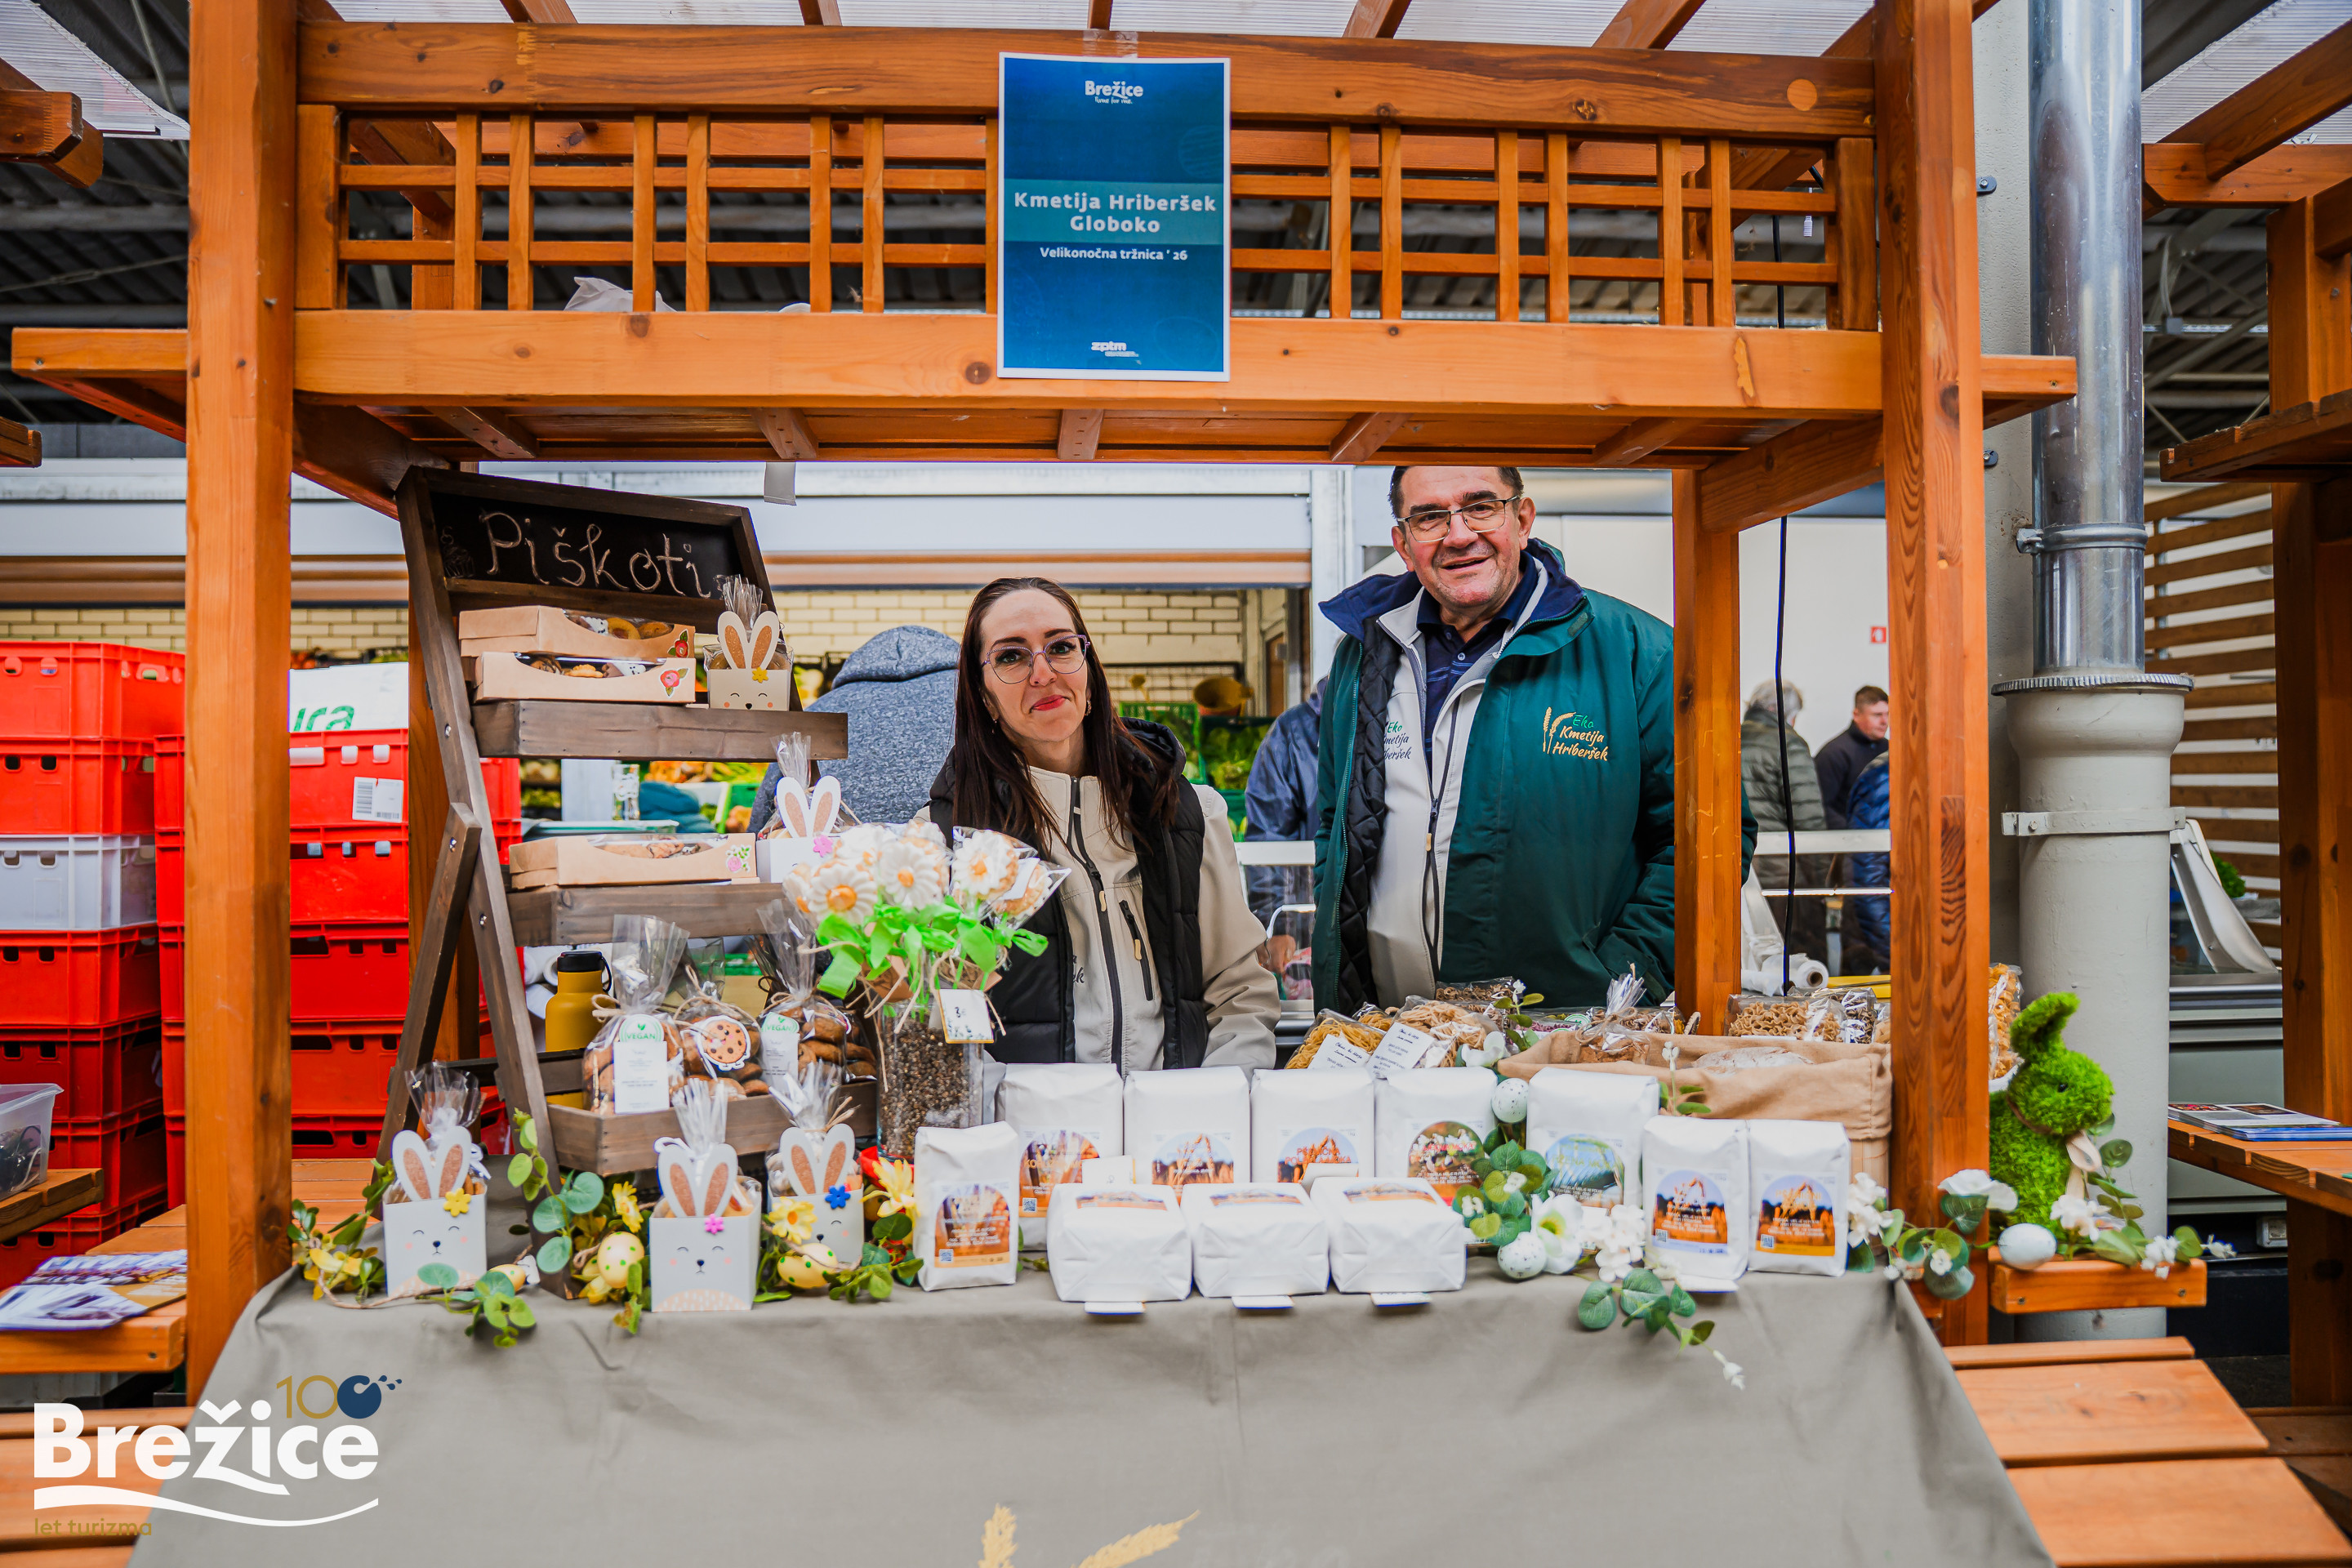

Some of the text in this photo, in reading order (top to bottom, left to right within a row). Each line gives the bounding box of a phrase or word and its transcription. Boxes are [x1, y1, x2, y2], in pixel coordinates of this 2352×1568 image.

[1085, 80, 1143, 99] Brežice
[1013, 192, 1216, 213] Kmetija Hriberšek
[1070, 216, 1160, 233] Globoko
[1040, 247, 1117, 260] Velikonočna
[1120, 248, 1164, 260] tržnica
[479, 510, 713, 599] Piškoti
[1387, 720, 1403, 733] Eko
[1572, 715, 1594, 728] Eko
[1383, 733, 1410, 749] metija
[1559, 725, 1605, 747] Kmetija
[1552, 741, 1609, 761] Hriberšek
